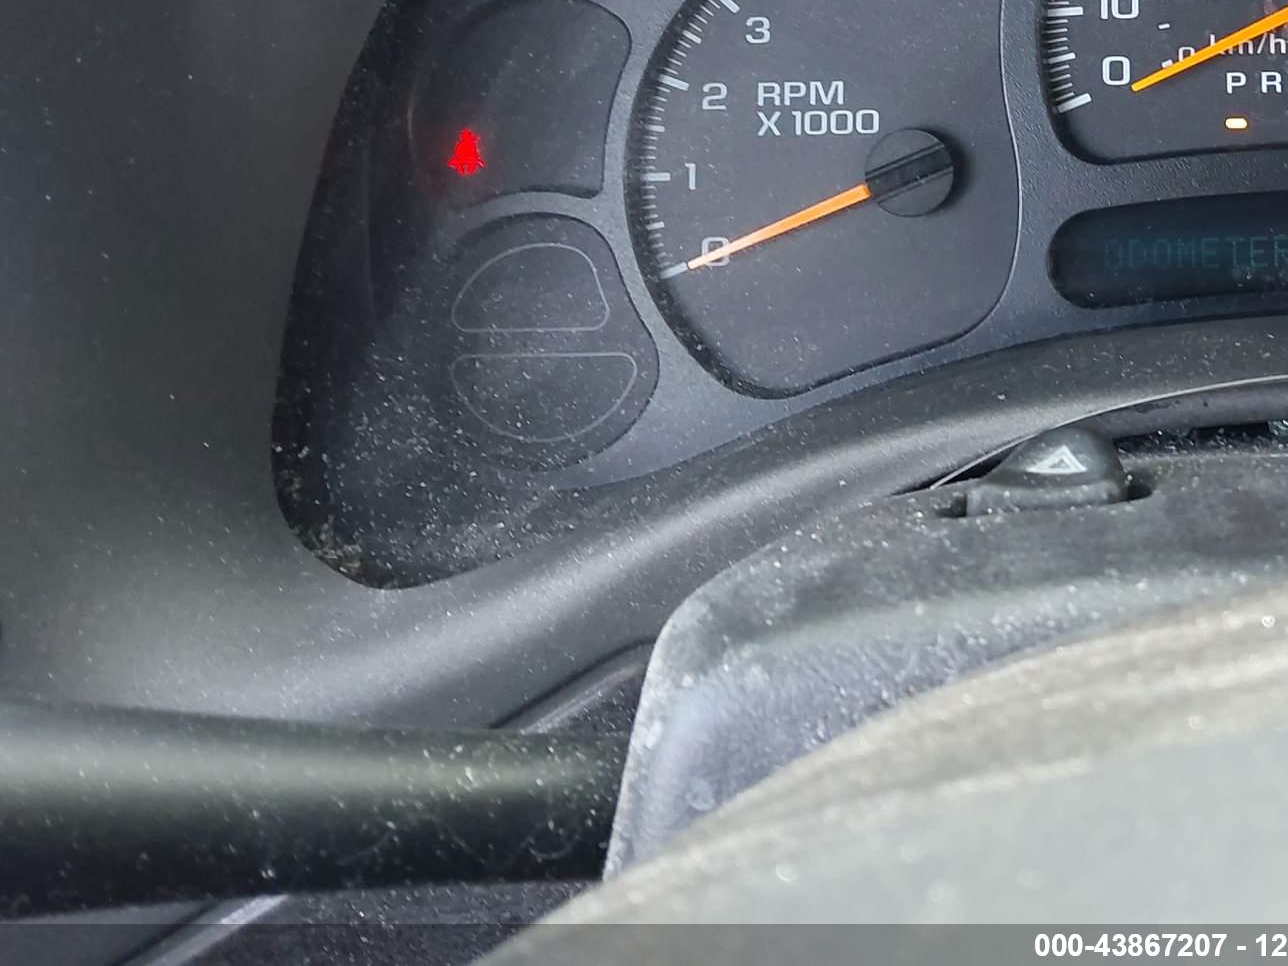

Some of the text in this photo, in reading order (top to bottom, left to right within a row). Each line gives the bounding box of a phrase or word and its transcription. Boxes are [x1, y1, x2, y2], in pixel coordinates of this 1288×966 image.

[746, 17, 771, 44] 3
[1102, 56, 1130, 86] 0
[1226, 72, 1246, 94] P
[1261, 71, 1282, 93] R
[702, 83, 728, 111] 2
[757, 81, 844, 106] RPM
[757, 109, 880, 136] X 1000
[685, 162, 696, 190] 1
